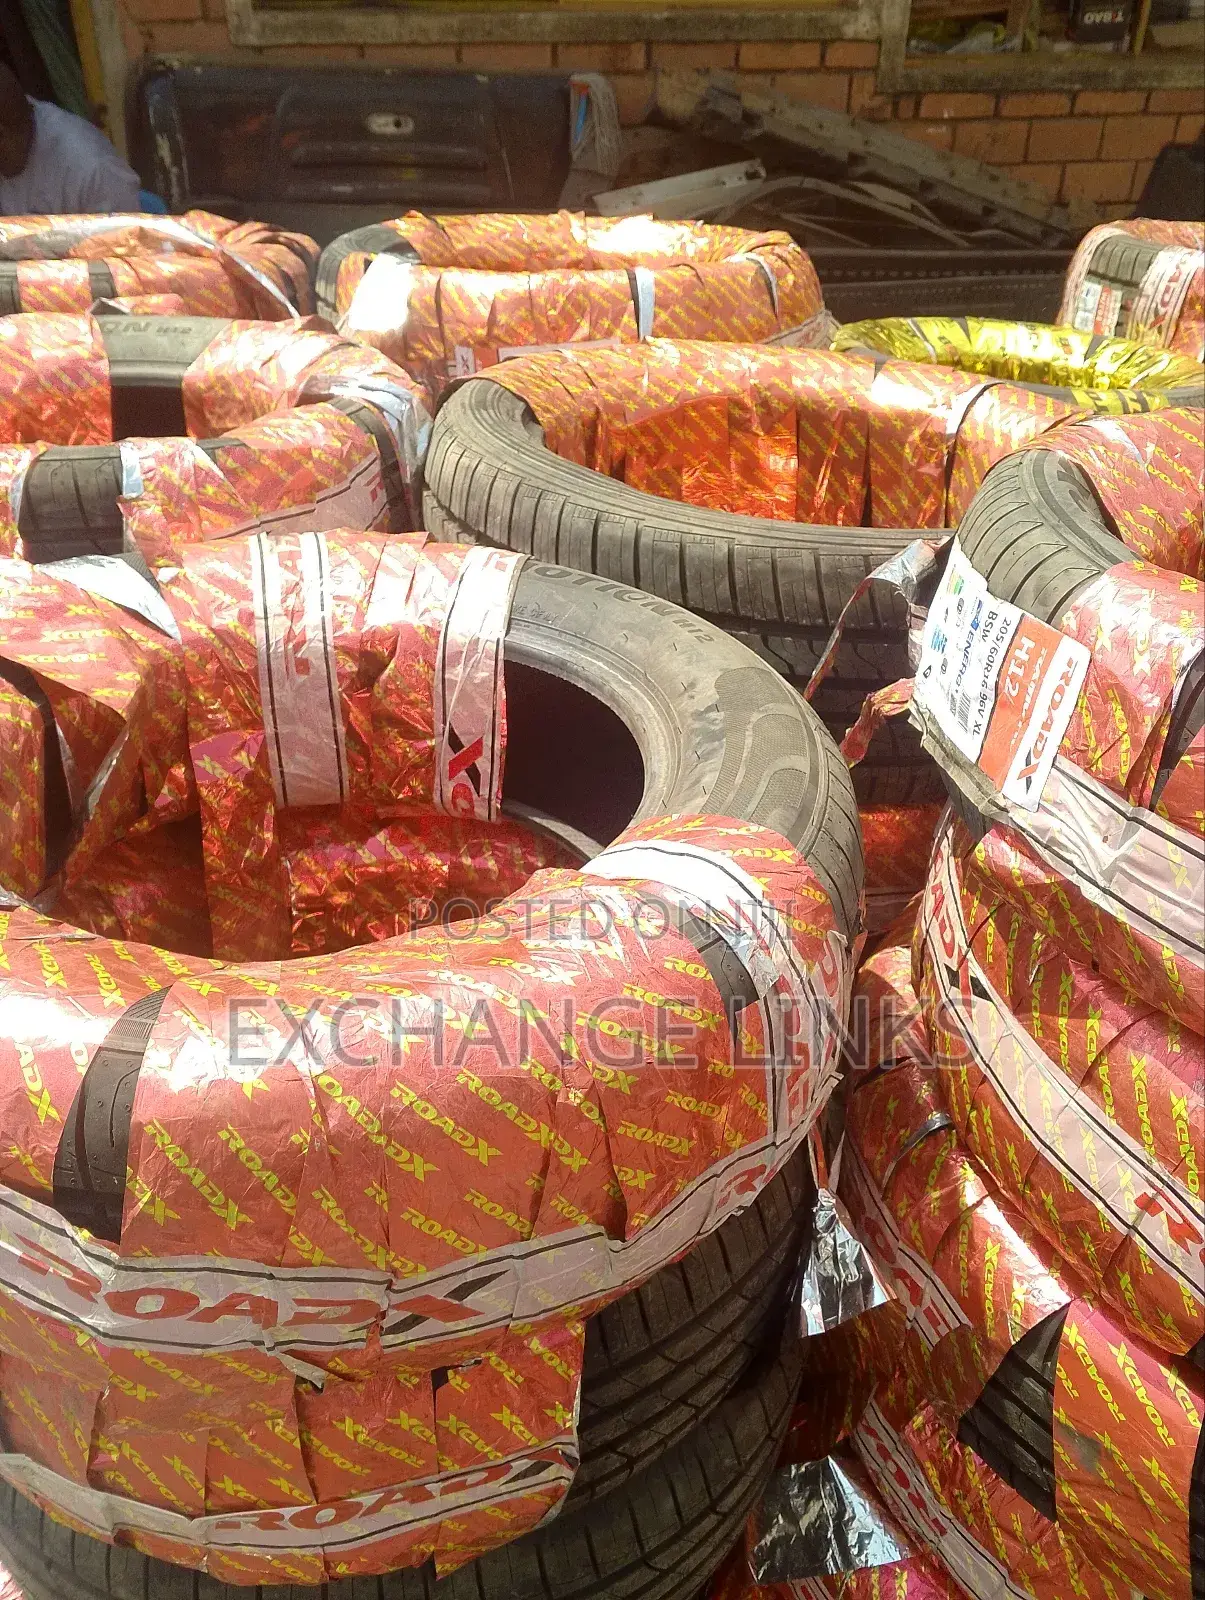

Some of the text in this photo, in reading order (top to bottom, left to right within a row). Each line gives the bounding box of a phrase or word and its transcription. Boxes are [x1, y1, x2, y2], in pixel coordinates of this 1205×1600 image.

[672, 617, 716, 645] H12
[981, 610, 998, 643] BSW
[972, 617, 1012, 736] 205/60R16 96V XL
[1004, 636, 1035, 697] H12
[1017, 657, 1079, 795] ROADX
[1045, 874, 1093, 952] ROAD
[427, 970, 550, 1028] ROADX
[576, 1010, 686, 1064] ROADX
[622, 983, 726, 1033] ROADX
[390, 1079, 503, 1167] ROADX
[456, 1067, 556, 1148] ROADX
[616, 1120, 697, 1157] ROADX
[144, 1118, 255, 1231] ROADX
[217, 1121, 298, 1217] ROAD
[463, 1188, 536, 1239] ROAD
[11, 1232, 511, 1335] ROADX
[985, 1237, 1001, 1338] ROADX
[1062, 1320, 1126, 1424] ROADX
[1107, 1341, 1177, 1449] ROADX
[1158, 1363, 1202, 1429] ADX
[331, 1416, 426, 1469] ROADX
[1094, 1430, 1171, 1524] ROADX
